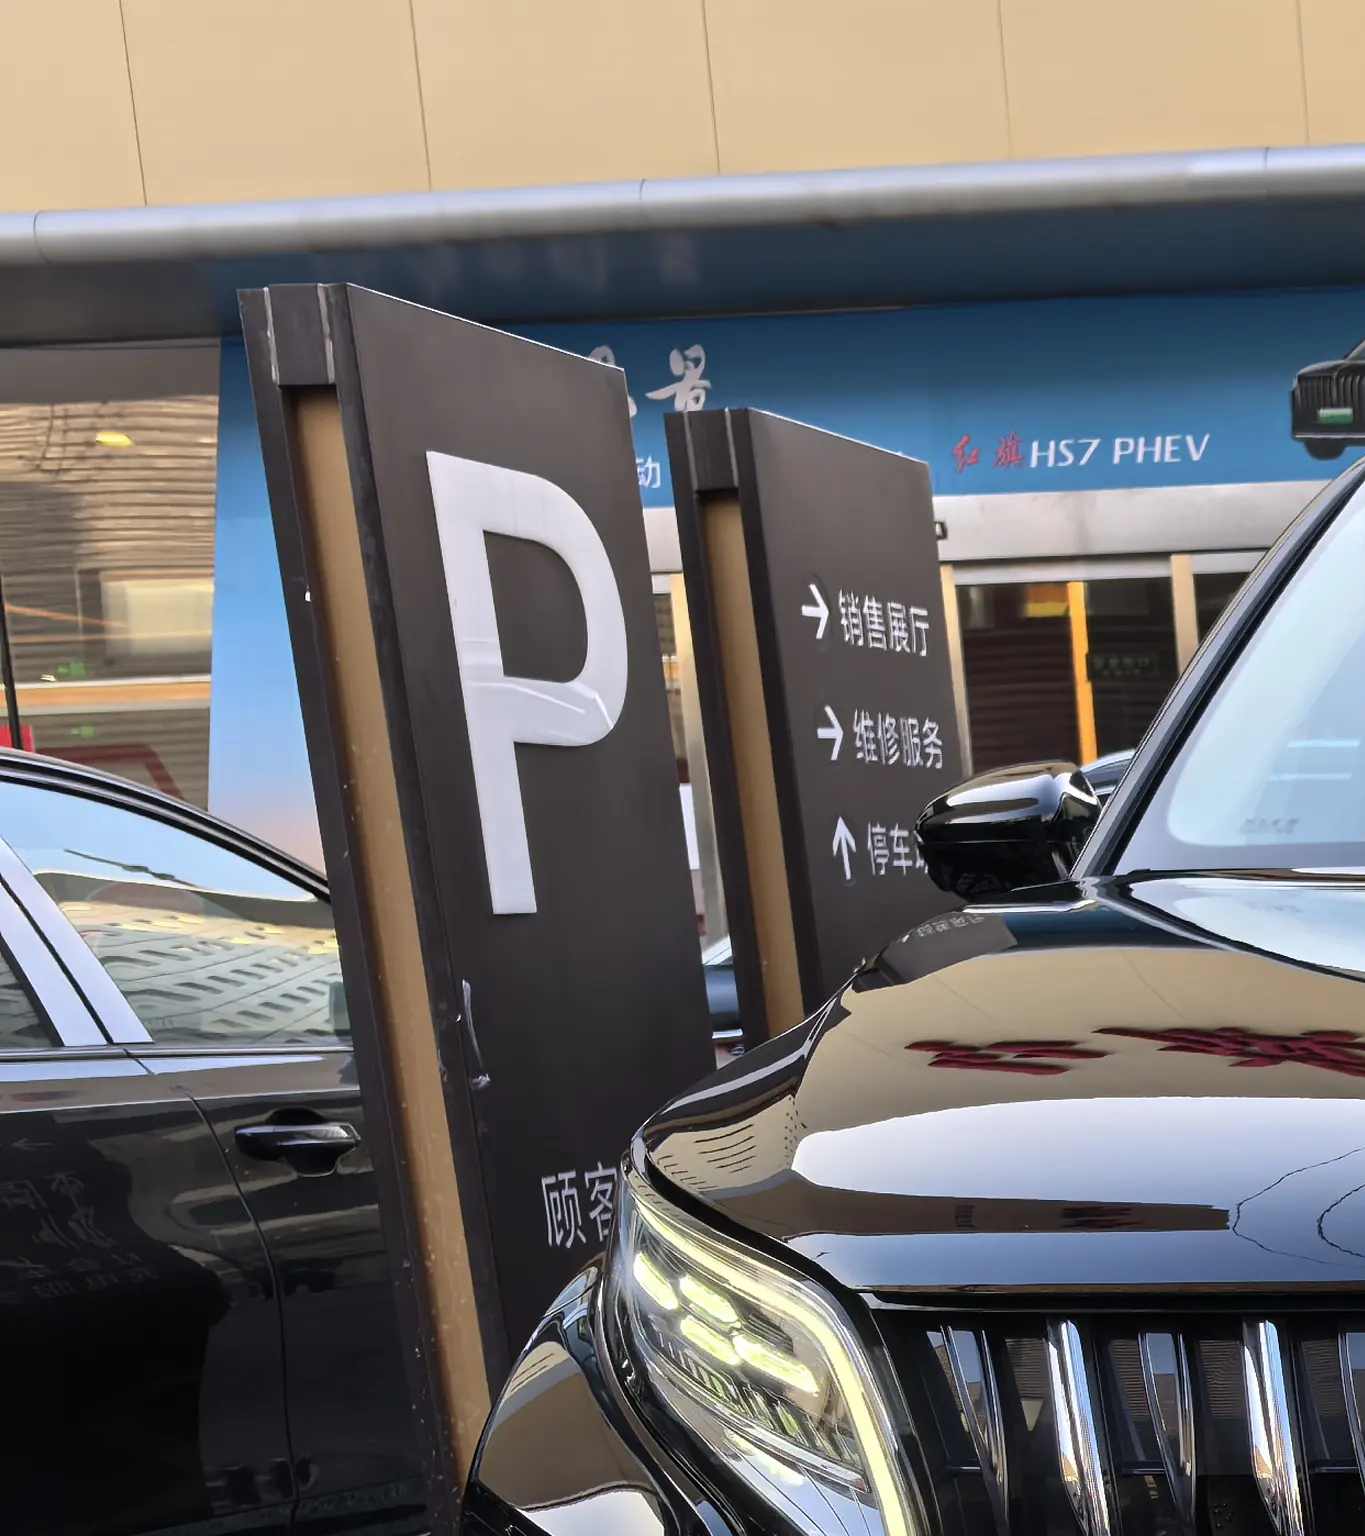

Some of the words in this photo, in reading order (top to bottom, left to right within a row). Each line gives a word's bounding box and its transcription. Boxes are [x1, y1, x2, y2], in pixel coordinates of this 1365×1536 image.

[1030, 438, 1101, 468] HS7
[1112, 433, 1210, 464] PHEV
[839, 590, 929, 656] 销售展厅
[426, 451, 628, 915] P
[853, 709, 943, 769] 维修服务
[867, 821, 928, 876] 停车
